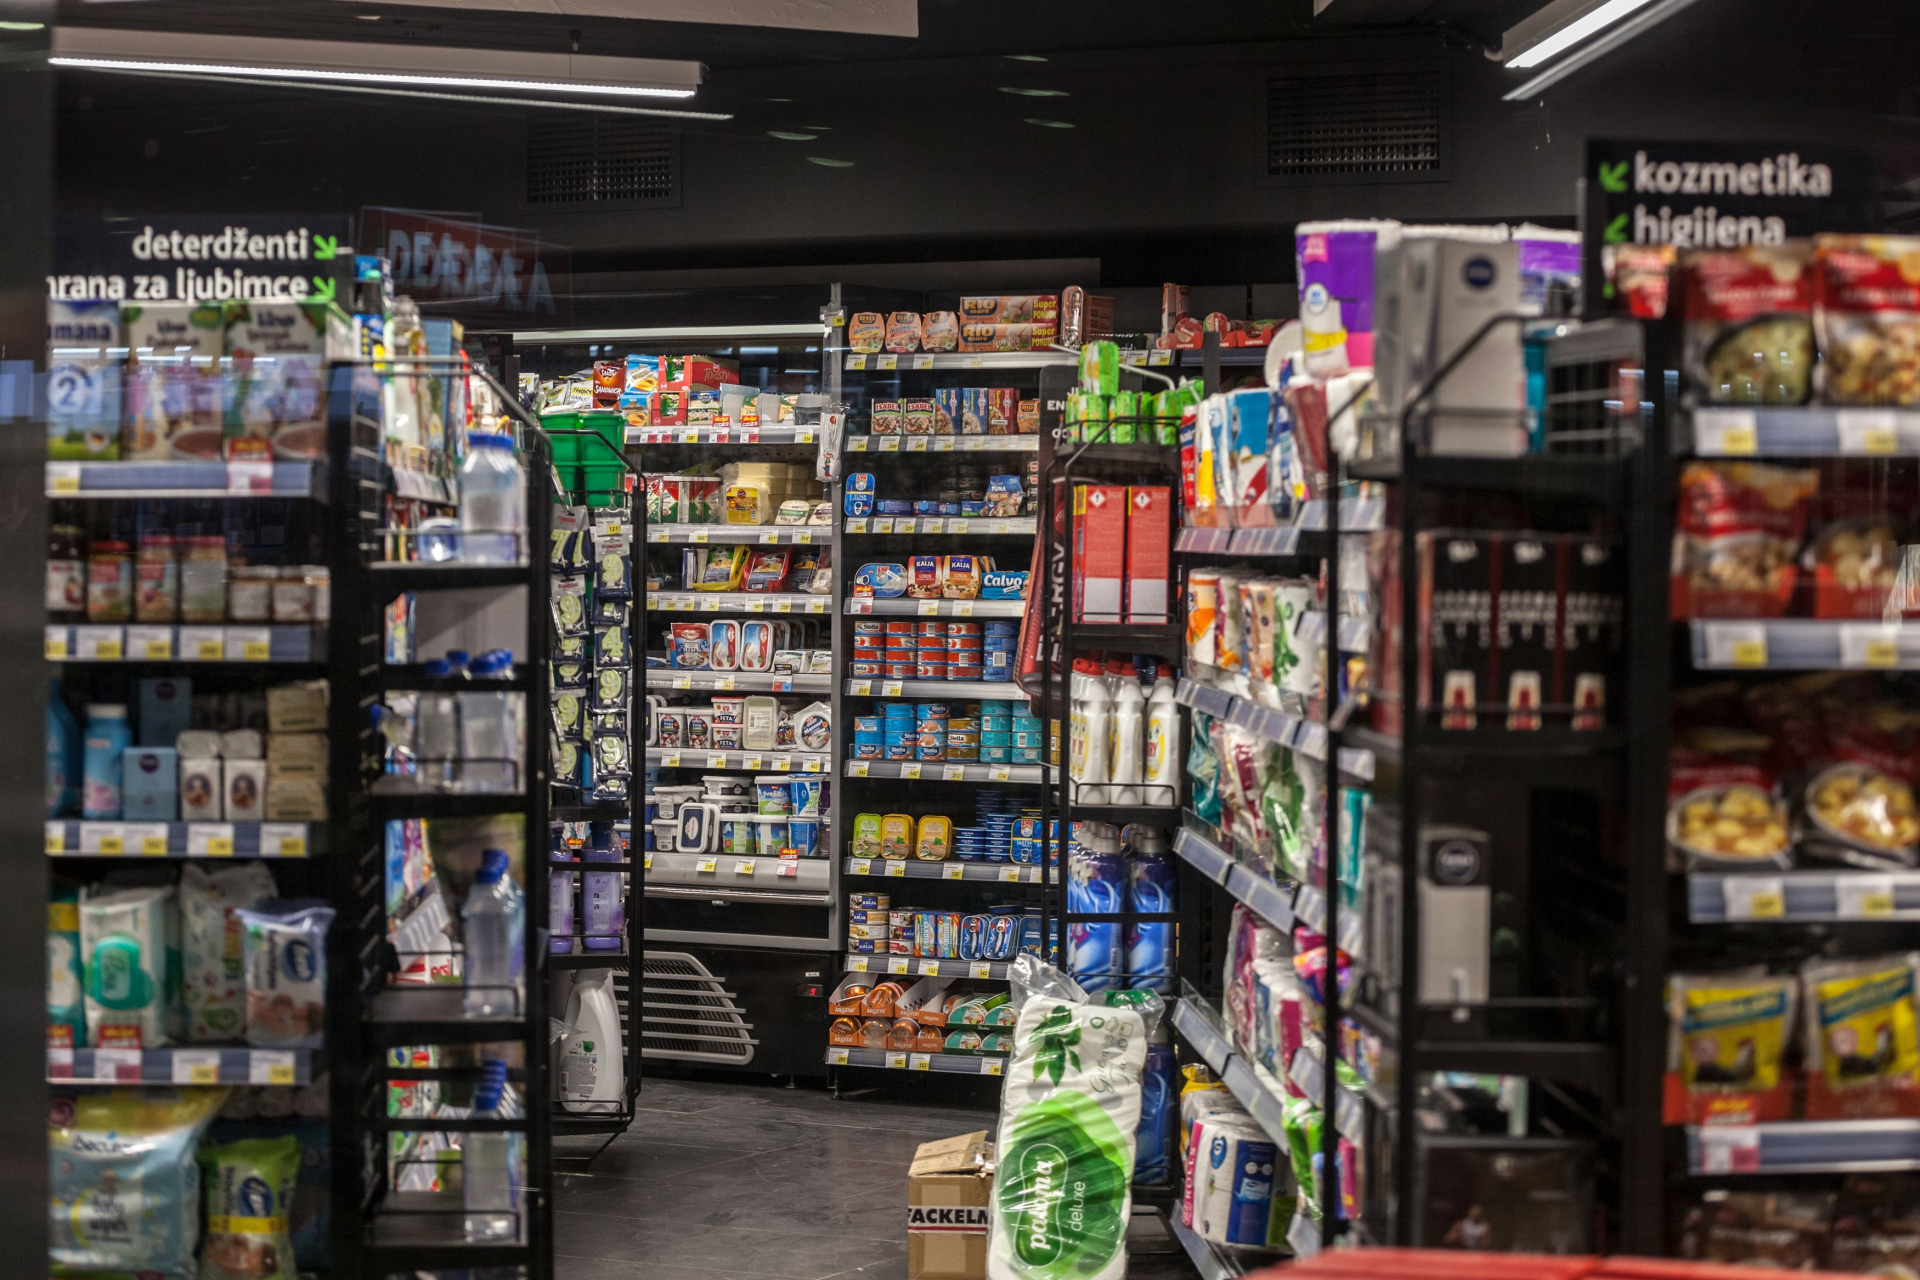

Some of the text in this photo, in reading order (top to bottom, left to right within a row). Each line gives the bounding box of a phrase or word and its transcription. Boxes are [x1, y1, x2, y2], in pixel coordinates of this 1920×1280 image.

[1634, 150, 1833, 196] kozmetika
[132, 226, 309, 260] deterdženti
[133, 275, 168, 300] za
[176, 267, 309, 304] ljubimce
[964, 300, 995, 309] RIO
[1033, 300, 1056, 310] Super
[1033, 311, 1056, 319] PONUDA
[963, 325, 994, 336] RIO
[1032, 327, 1055, 337] Super
[704, 367, 730, 382] Toasty
[876, 403, 899, 411] ISABEL
[908, 403, 931, 411] ISABEL
[983, 575, 1022, 586] Calvo
[1068, 1181, 1086, 1231] deluxe
